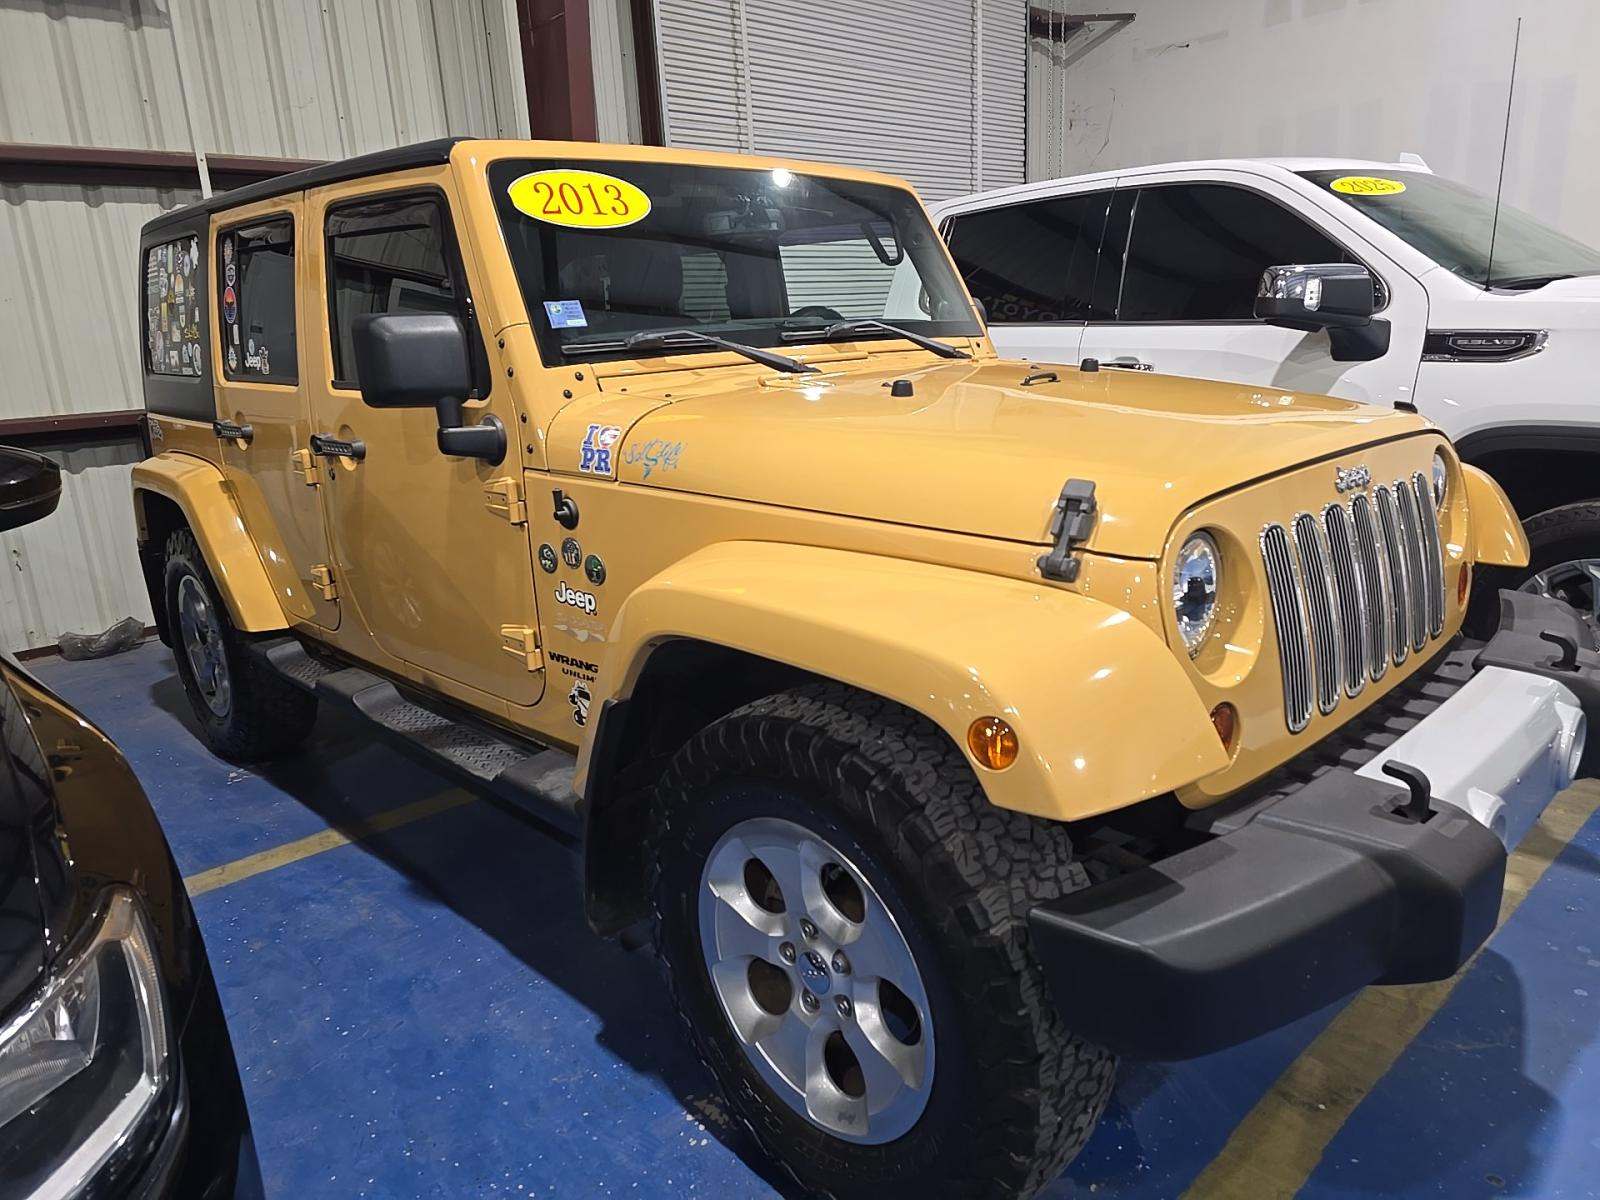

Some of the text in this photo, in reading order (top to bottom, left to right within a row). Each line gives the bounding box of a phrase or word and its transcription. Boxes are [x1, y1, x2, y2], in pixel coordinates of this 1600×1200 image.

[533, 181, 630, 217] 2013
[245, 351, 261, 371] Jeep
[580, 447, 612, 474] PR
[555, 580, 597, 616] Jeep
[548, 651, 599, 674] WRANG
